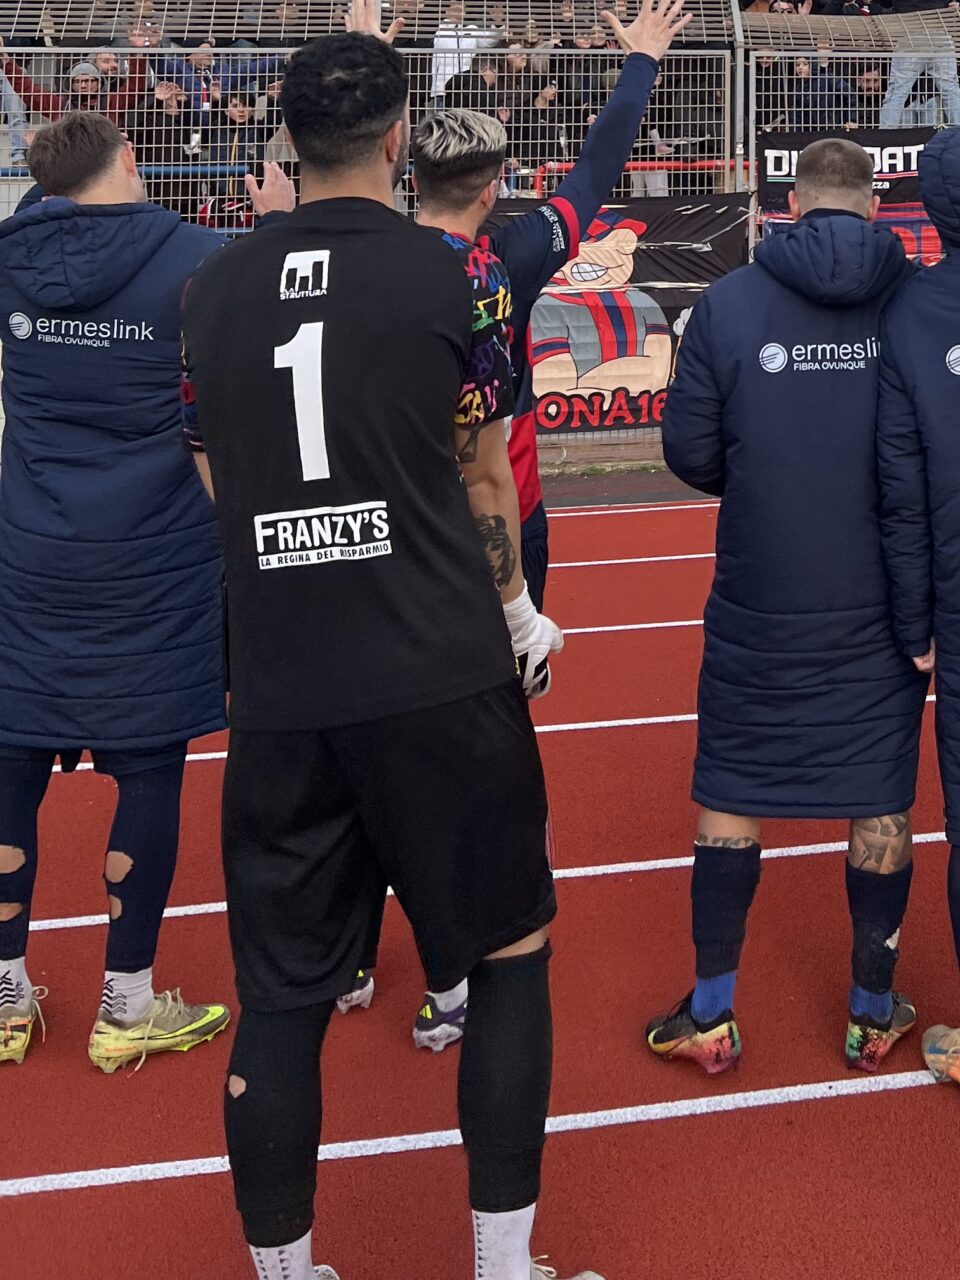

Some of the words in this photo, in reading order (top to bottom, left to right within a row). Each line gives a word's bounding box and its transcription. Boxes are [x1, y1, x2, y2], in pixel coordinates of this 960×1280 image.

[36, 318, 154, 341] ermeslink
[38, 334, 64, 344] FIBRA
[65, 336, 110, 348] OVUNQUE
[792, 337, 880, 361] ermesli
[793, 362, 820, 371] FIBRA
[821, 361, 866, 371] OVUNQUE
[274, 321, 330, 481] 1
[254, 503, 390, 553] FRANZY'S
[261, 558, 272, 567] LA
[277, 552, 311, 565] REGINA
[316, 549, 335, 561] DEL
[339, 542, 389, 558] RISPARMIO
